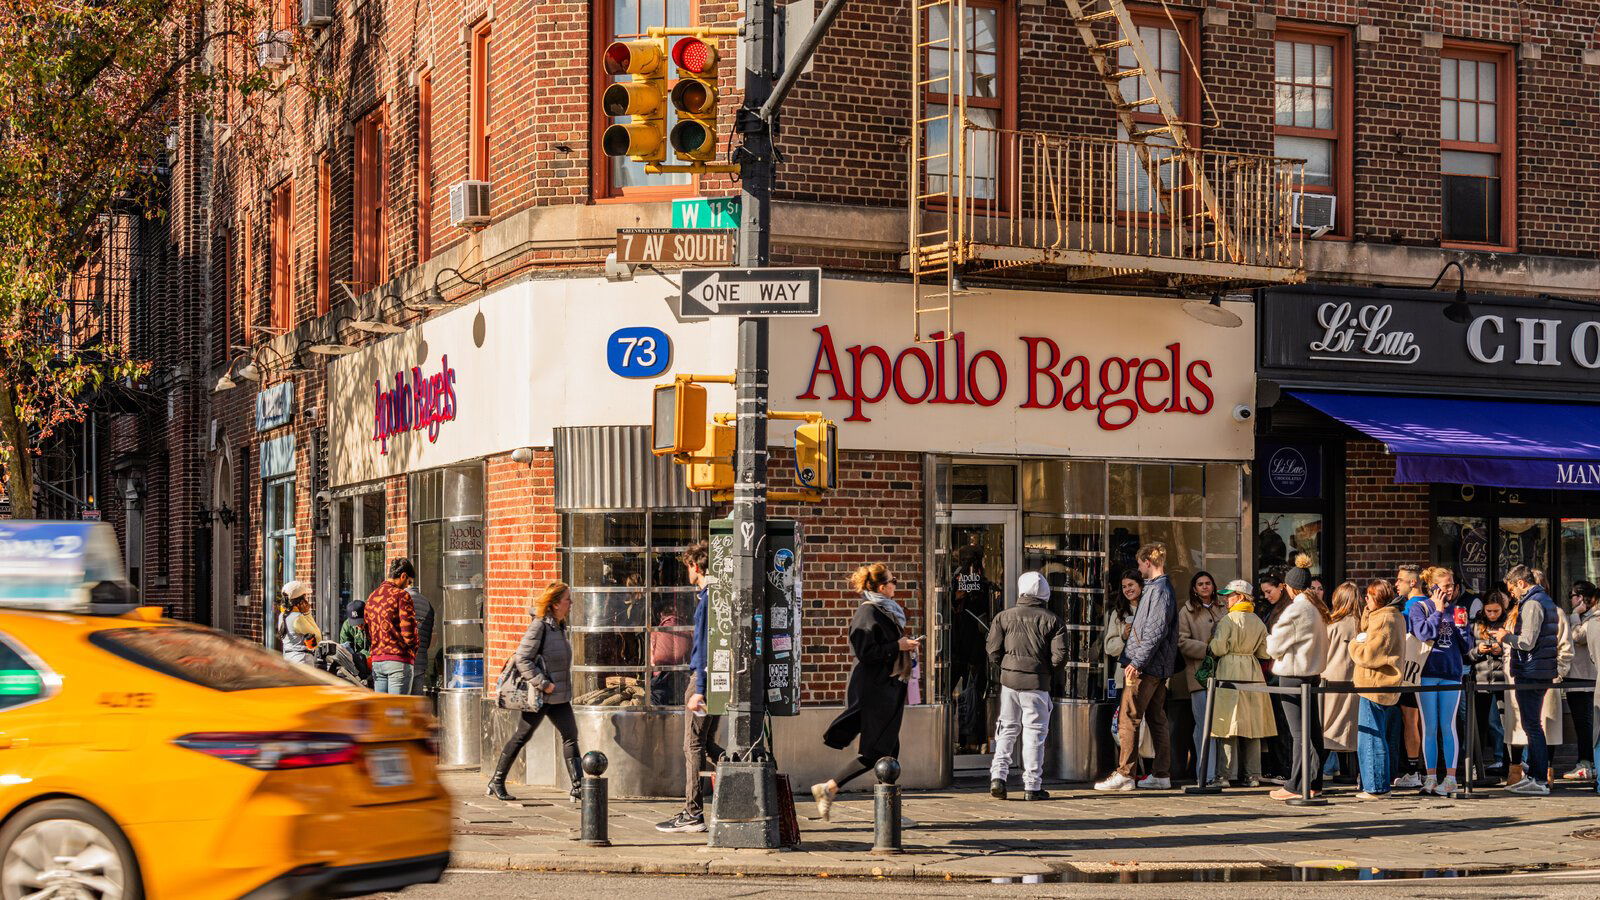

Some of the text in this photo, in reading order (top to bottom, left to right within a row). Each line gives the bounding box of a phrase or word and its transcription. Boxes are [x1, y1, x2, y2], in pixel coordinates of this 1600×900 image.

[682, 203, 699, 228] W
[710, 202, 721, 228] 11
[622, 234, 727, 261] 7 AV SOUTH
[702, 283, 801, 302] ONE WAY
[1310, 302, 1420, 363] Li-Lac
[1467, 315, 1600, 368] CHO
[618, 336, 657, 367] 73
[796, 324, 1215, 431] Apollo Bagels
[373, 354, 456, 456] Apollo Bagels
[449, 538, 482, 550] Bagels
[450, 526, 482, 539] Apollo
[958, 572, 980, 583] Apollo
[958, 582, 980, 593] Bagels
